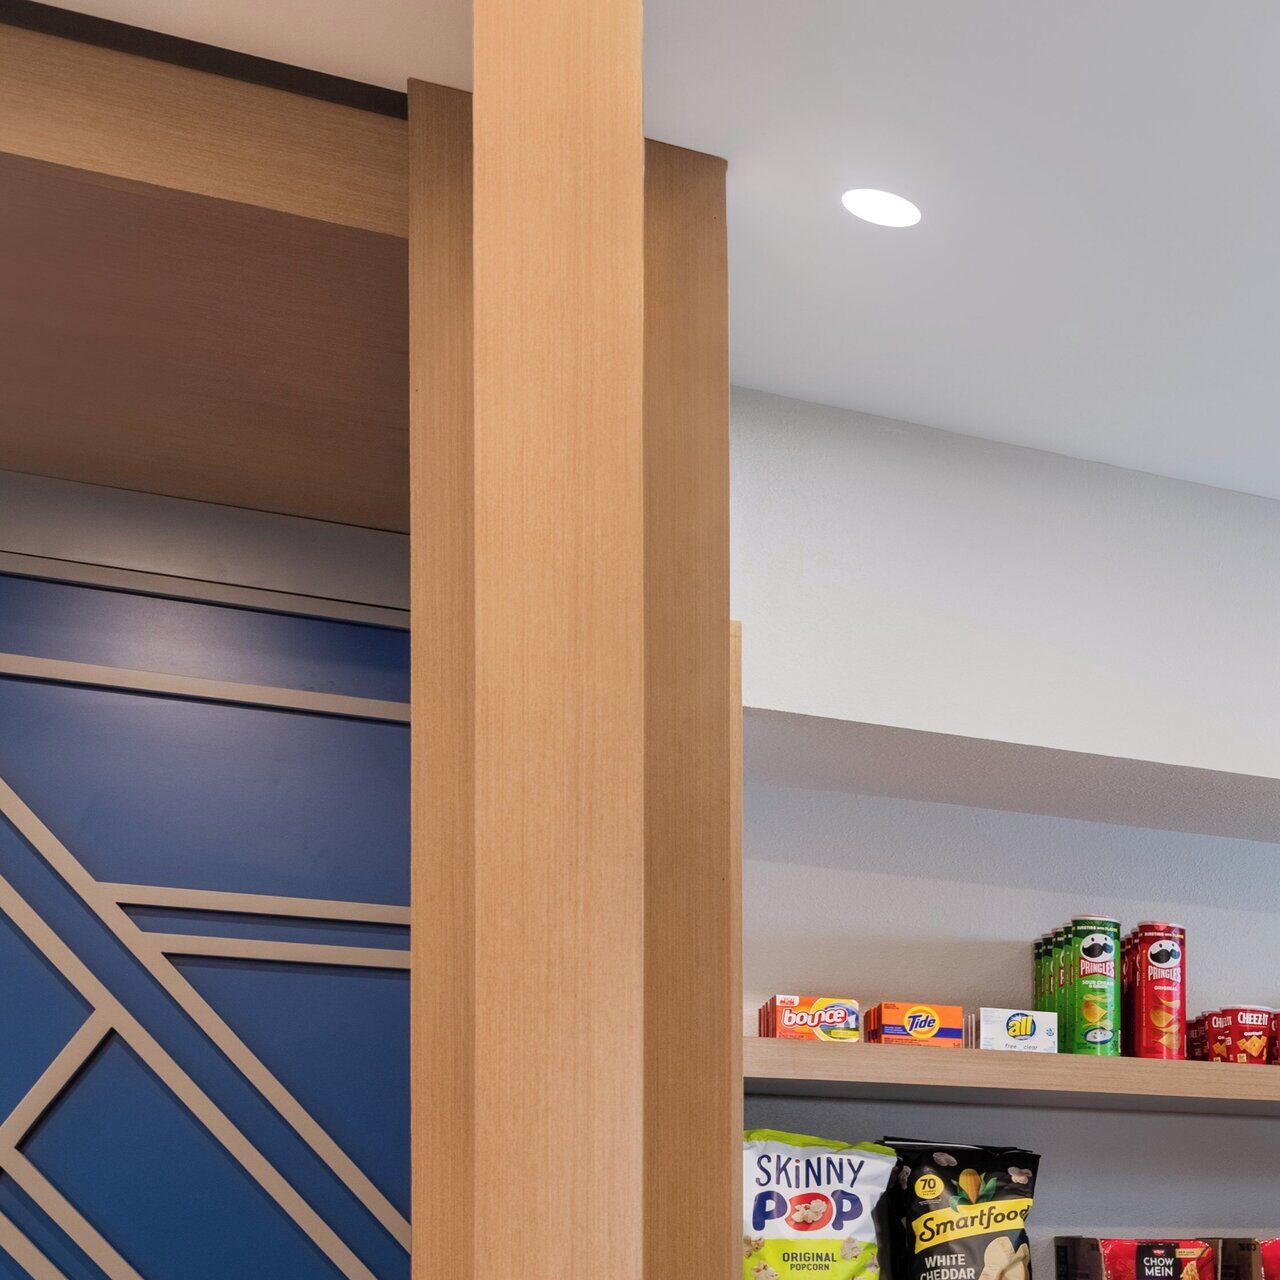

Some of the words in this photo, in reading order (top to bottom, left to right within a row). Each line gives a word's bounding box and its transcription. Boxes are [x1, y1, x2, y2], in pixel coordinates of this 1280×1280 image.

[1080, 960, 1115, 978] PRINGLES
[1148, 966, 1182, 984] PRINGLES
[783, 1008, 847, 1028] bounce
[907, 1014, 936, 1032] Tide
[1007, 1016, 1033, 1037] all
[920, 1178, 937, 1190] 70
[752, 1189, 864, 1232] POP
[918, 1204, 1032, 1243] Smartfood
[782, 1252, 837, 1263] ORIGINAL
[925, 1253, 966, 1269] WHITE
[1143, 1257, 1175, 1266] CHOW
[790, 1263, 830, 1271] POPCORN
[1145, 1266, 1174, 1277] MEIN
